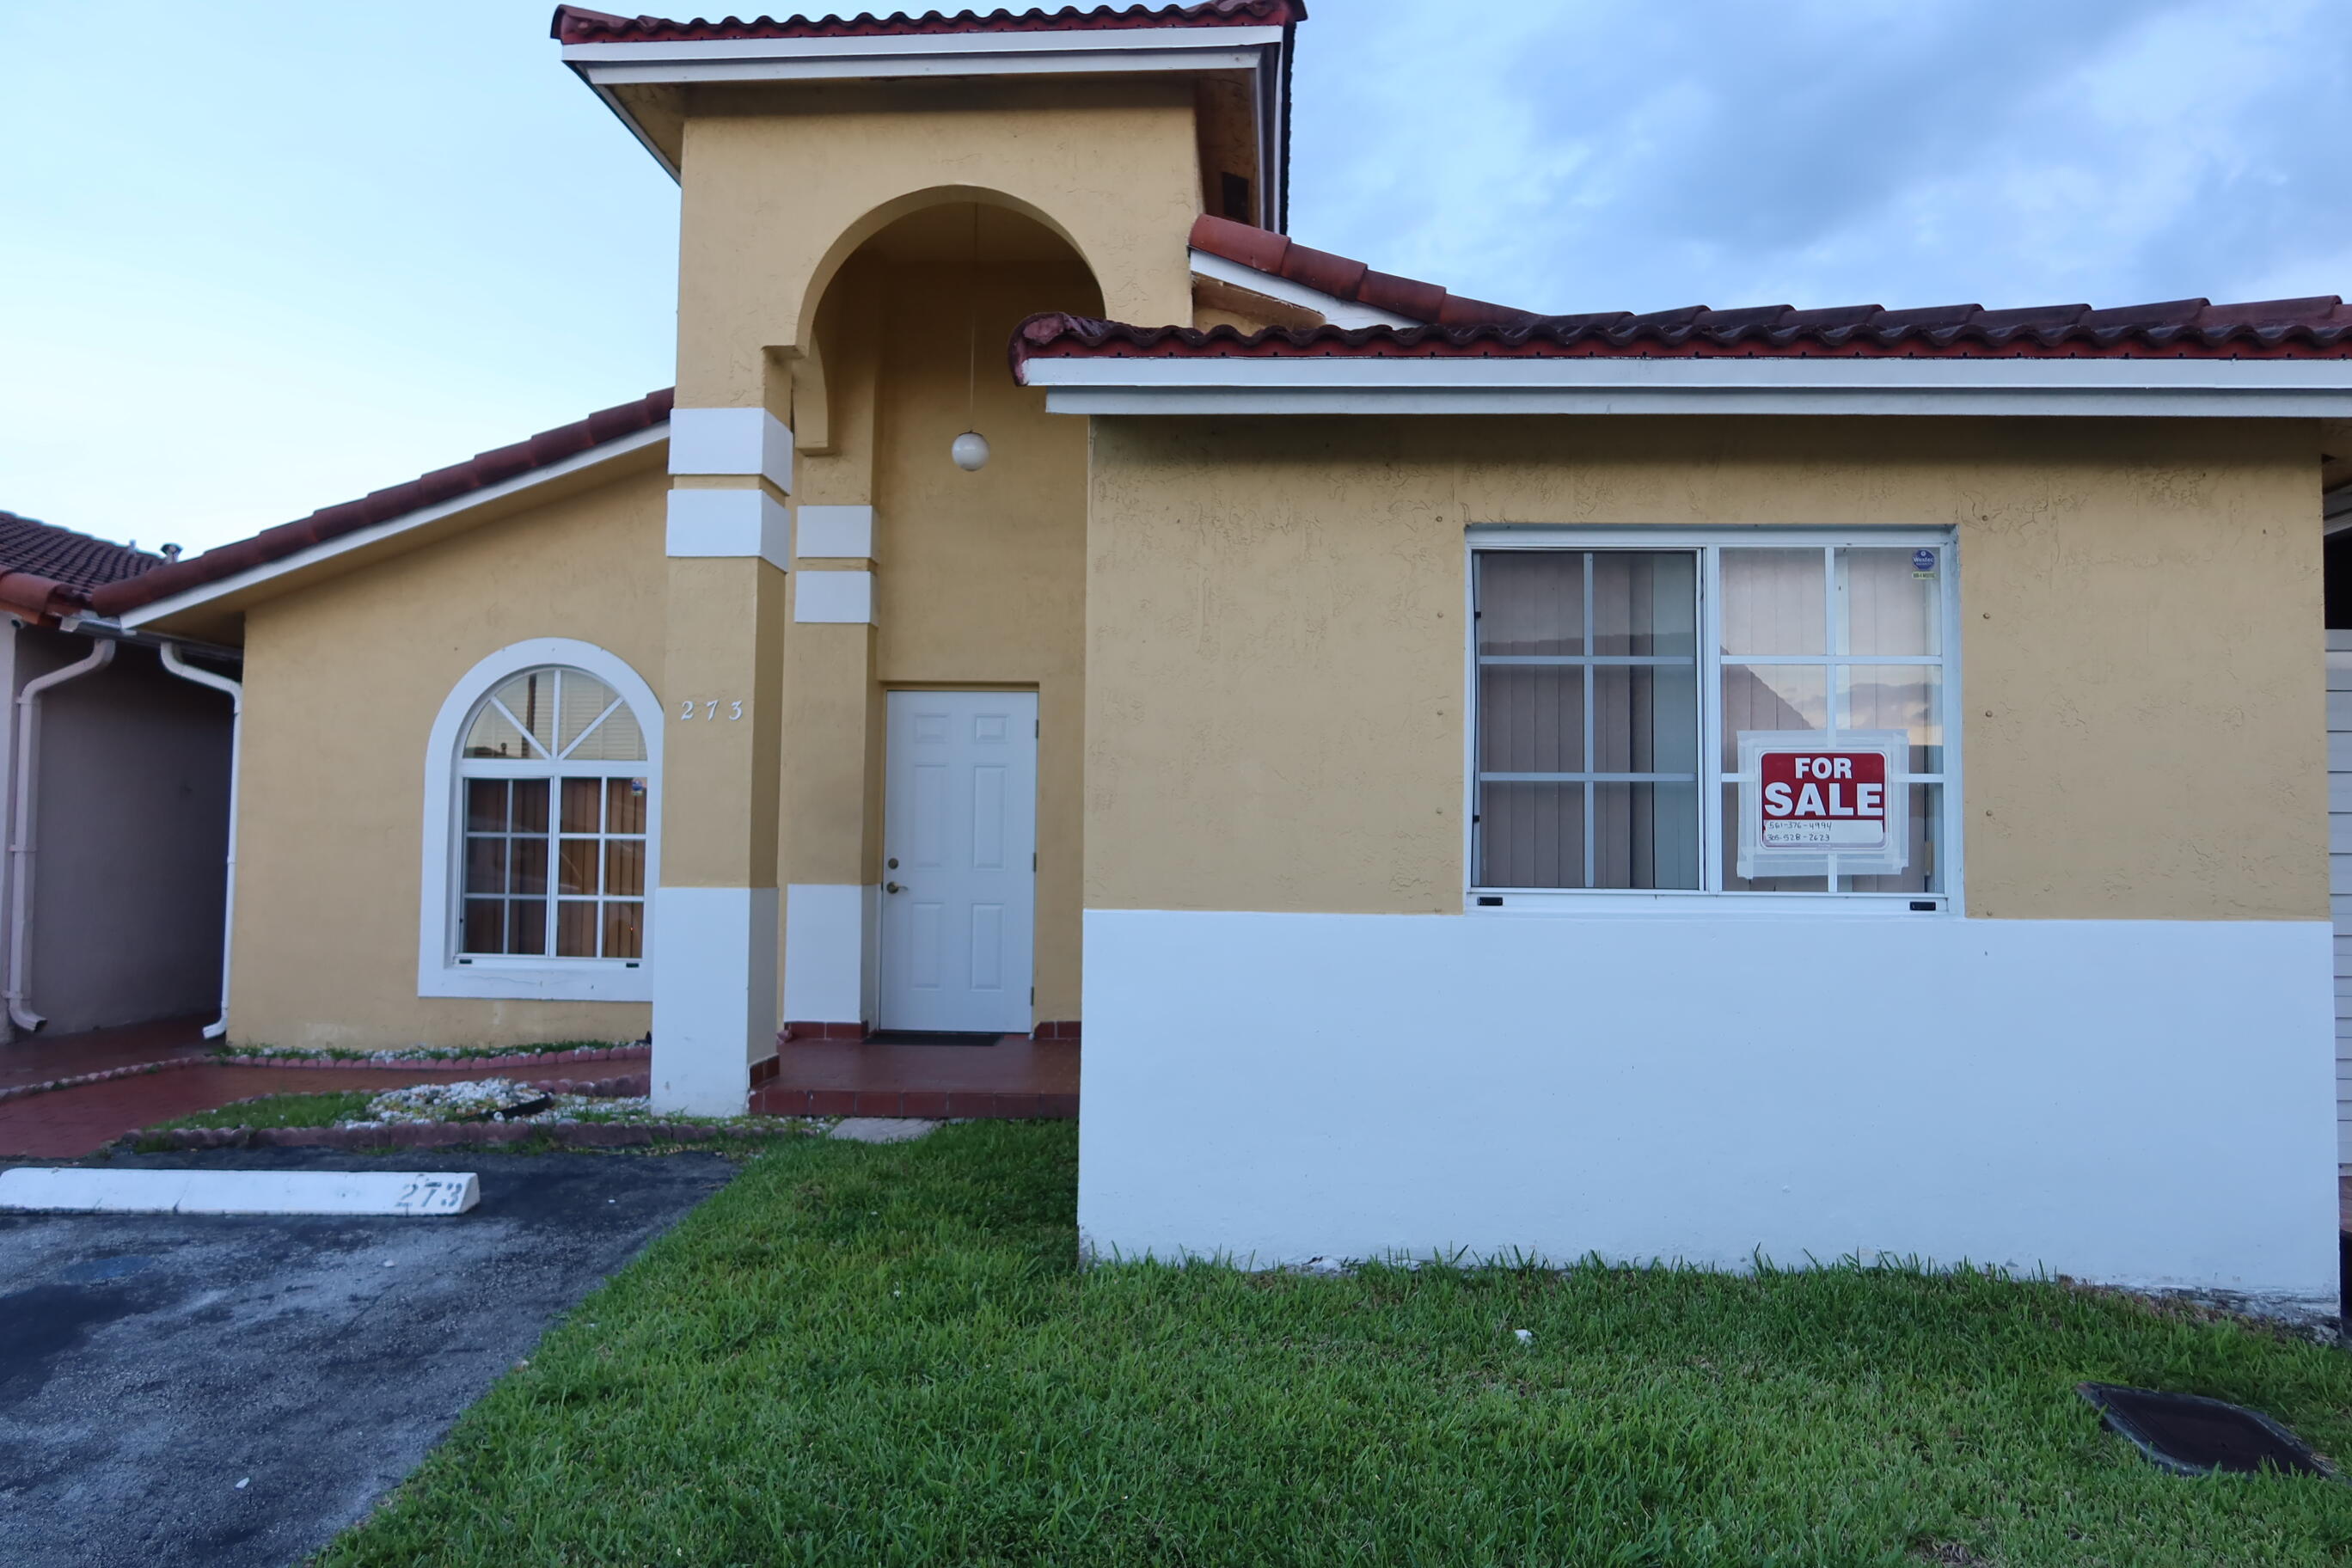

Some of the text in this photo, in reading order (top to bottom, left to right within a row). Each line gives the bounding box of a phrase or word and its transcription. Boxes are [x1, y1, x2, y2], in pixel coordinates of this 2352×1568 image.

[681, 699, 743, 722] 273
[1795, 757, 1853, 780] FOR
[1764, 781, 1883, 817] SALE
[395, 1181, 462, 1207] 273
